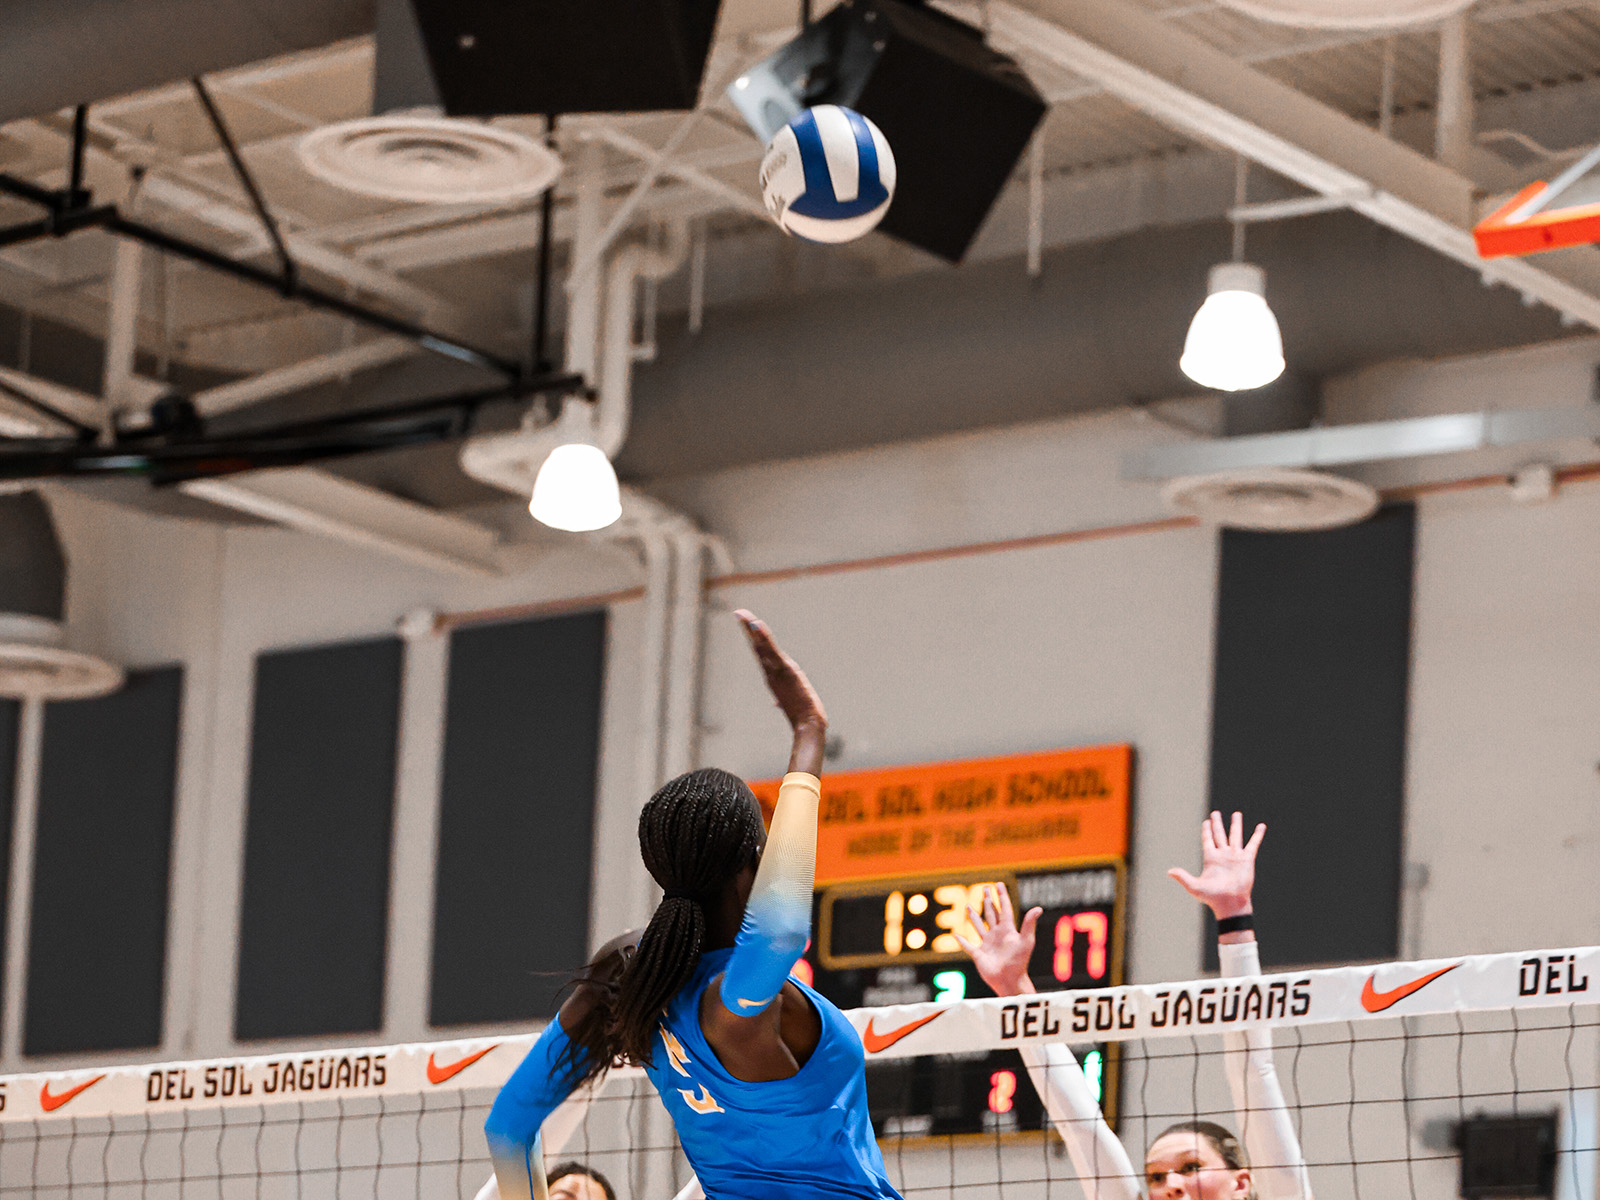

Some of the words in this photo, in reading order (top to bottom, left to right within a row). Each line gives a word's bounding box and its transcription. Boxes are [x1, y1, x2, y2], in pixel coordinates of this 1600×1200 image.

[1005, 766, 1113, 809] SCHOOL
[1053, 911, 1108, 982] 17
[1519, 954, 1588, 996] DEL
[1001, 1002, 1060, 1040] DEL
[1072, 995, 1136, 1033] SOL
[1151, 979, 1312, 1028] JAGUARS
[146, 1070, 195, 1102] DEL
[203, 1065, 253, 1098] SOL
[262, 1055, 387, 1094] JAGUARS
